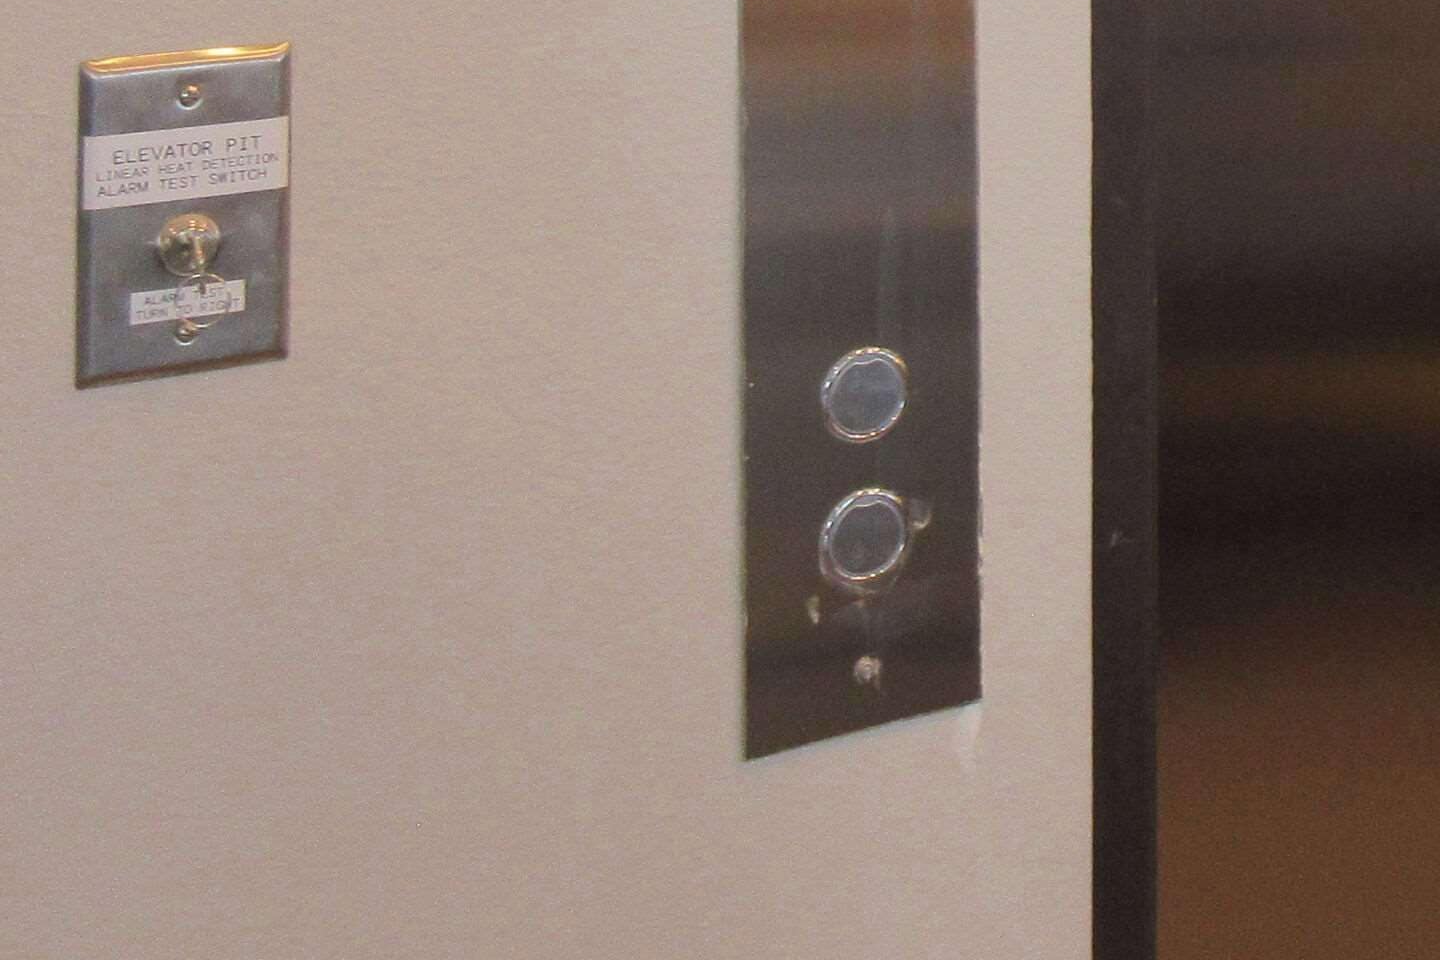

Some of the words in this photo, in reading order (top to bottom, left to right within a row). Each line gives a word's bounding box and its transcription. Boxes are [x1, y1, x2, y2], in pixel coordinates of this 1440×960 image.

[112, 141, 213, 165] ELEVATOR
[226, 135, 262, 152] PIT
[96, 166, 149, 182] LINEAR
[159, 161, 193, 175] HEAT
[202, 152, 279, 171] DETECTION
[97, 181, 149, 198] ALARM
[160, 175, 199, 190] TEST
[208, 169, 267, 185] SWITCH
